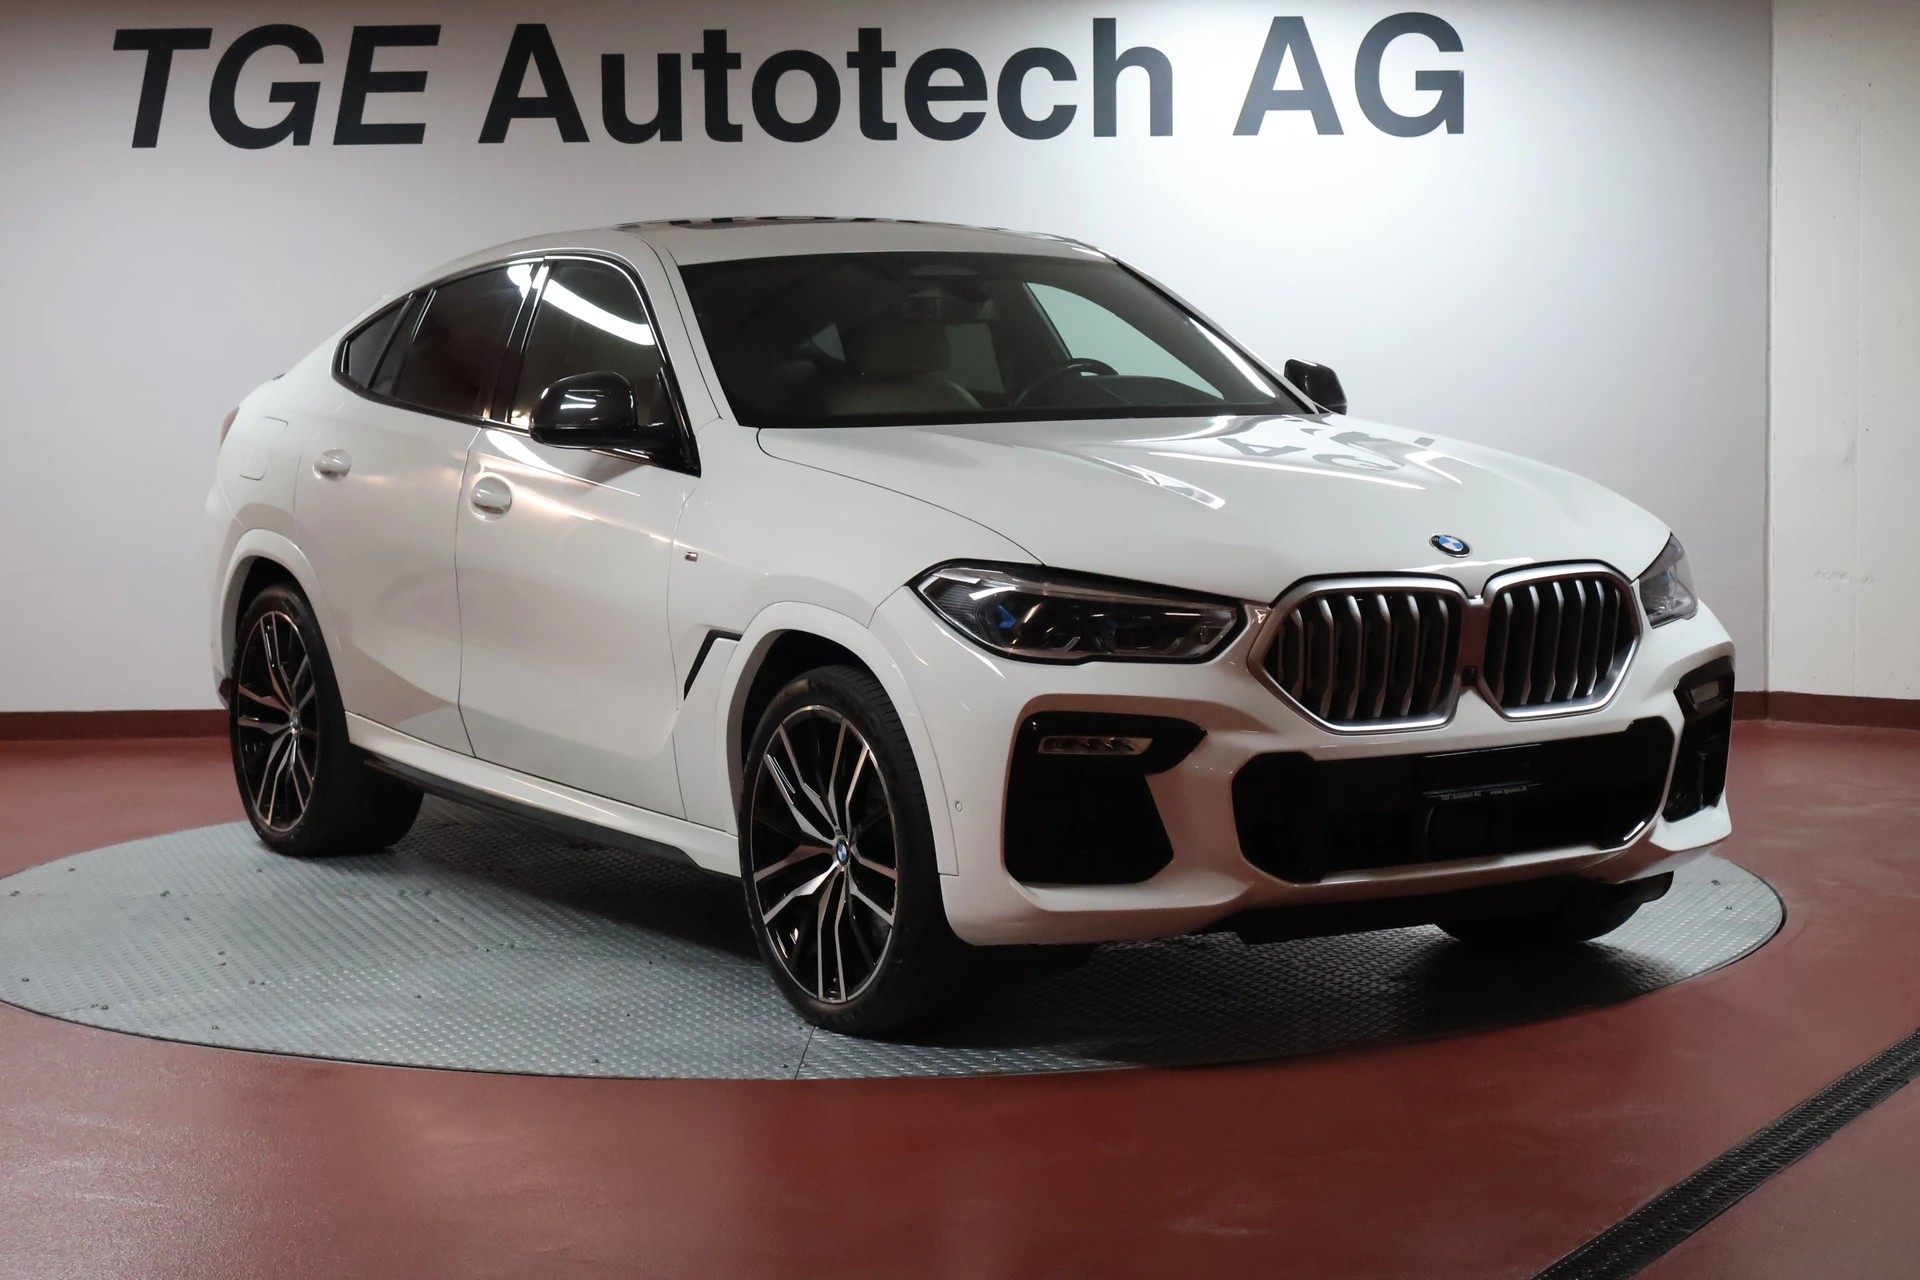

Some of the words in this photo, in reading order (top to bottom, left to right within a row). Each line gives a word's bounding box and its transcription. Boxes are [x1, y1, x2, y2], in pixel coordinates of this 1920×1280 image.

[113, 23, 442, 150] TGE
[477, 18, 1174, 145] Autotech
[1232, 12, 1465, 138] AG
